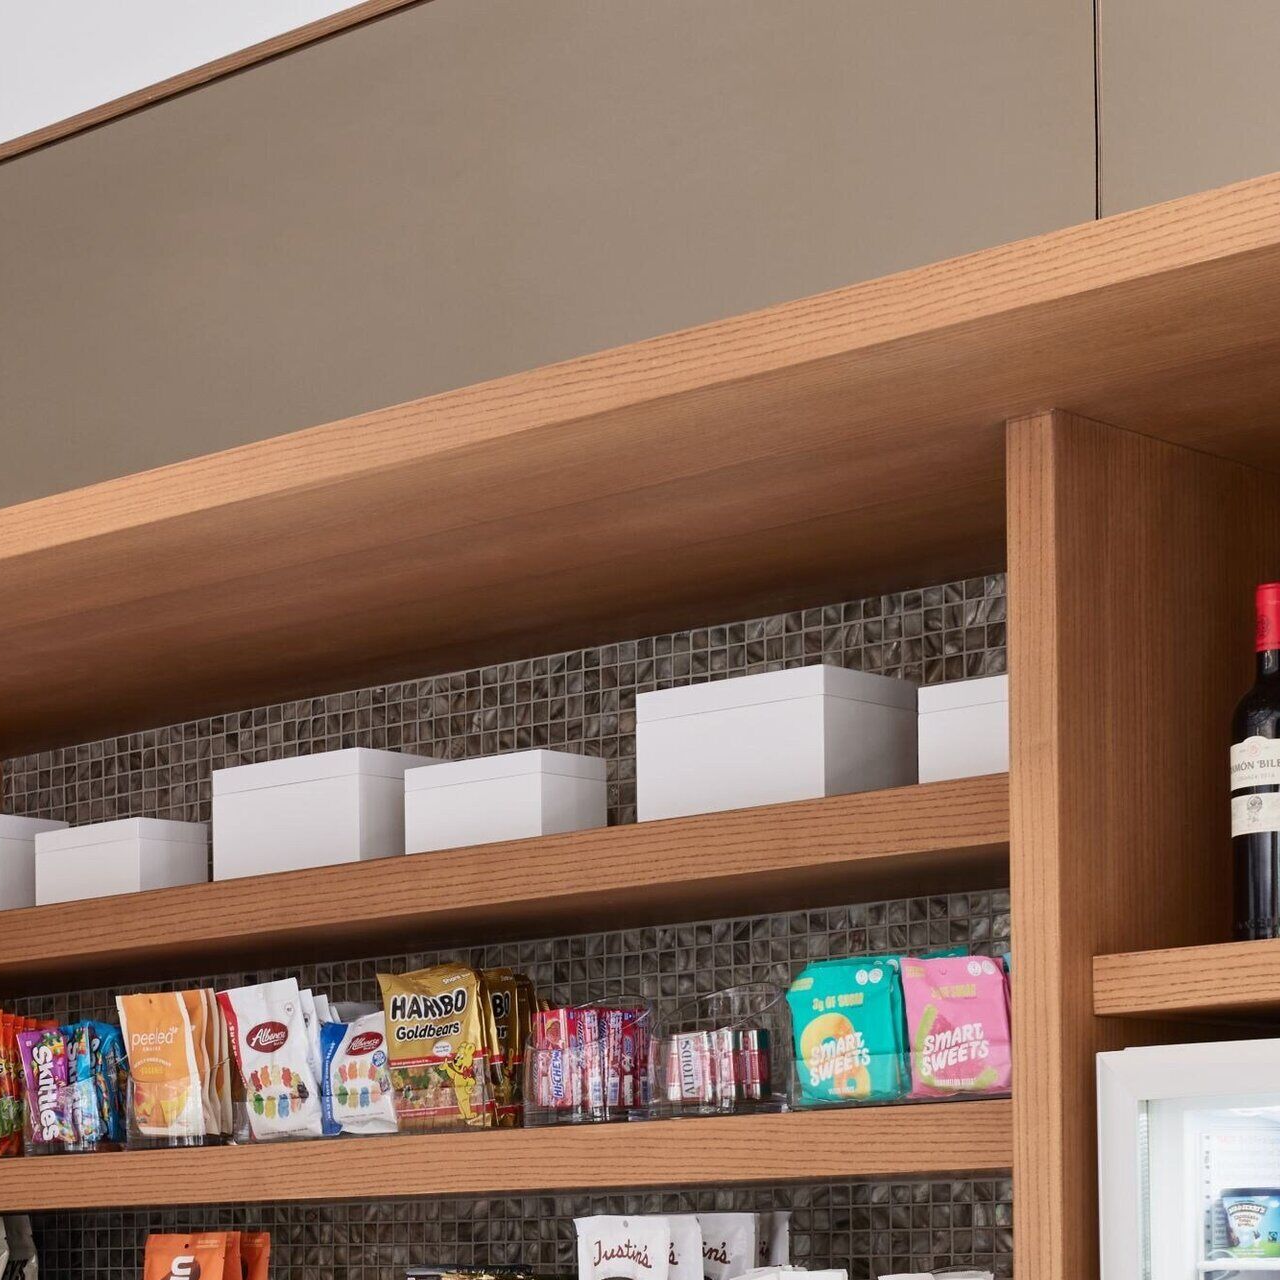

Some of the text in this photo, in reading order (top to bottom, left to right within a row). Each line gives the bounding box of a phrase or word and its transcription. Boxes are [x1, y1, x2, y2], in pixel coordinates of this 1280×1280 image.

[391, 989, 467, 1019] HARIBO
[131, 1028, 174, 1051] peeled
[396, 1022, 460, 1040] Goldbears
[923, 1022, 985, 1055] SMART
[811, 1031, 866, 1065] SMART
[922, 1040, 990, 1076] SWEETS
[681, 1039, 696, 1095] ALTOIDS
[809, 1048, 871, 1087] SWEETS
[33, 1046, 59, 1141] Skittles
[594, 1239, 652, 1269] Justin's
